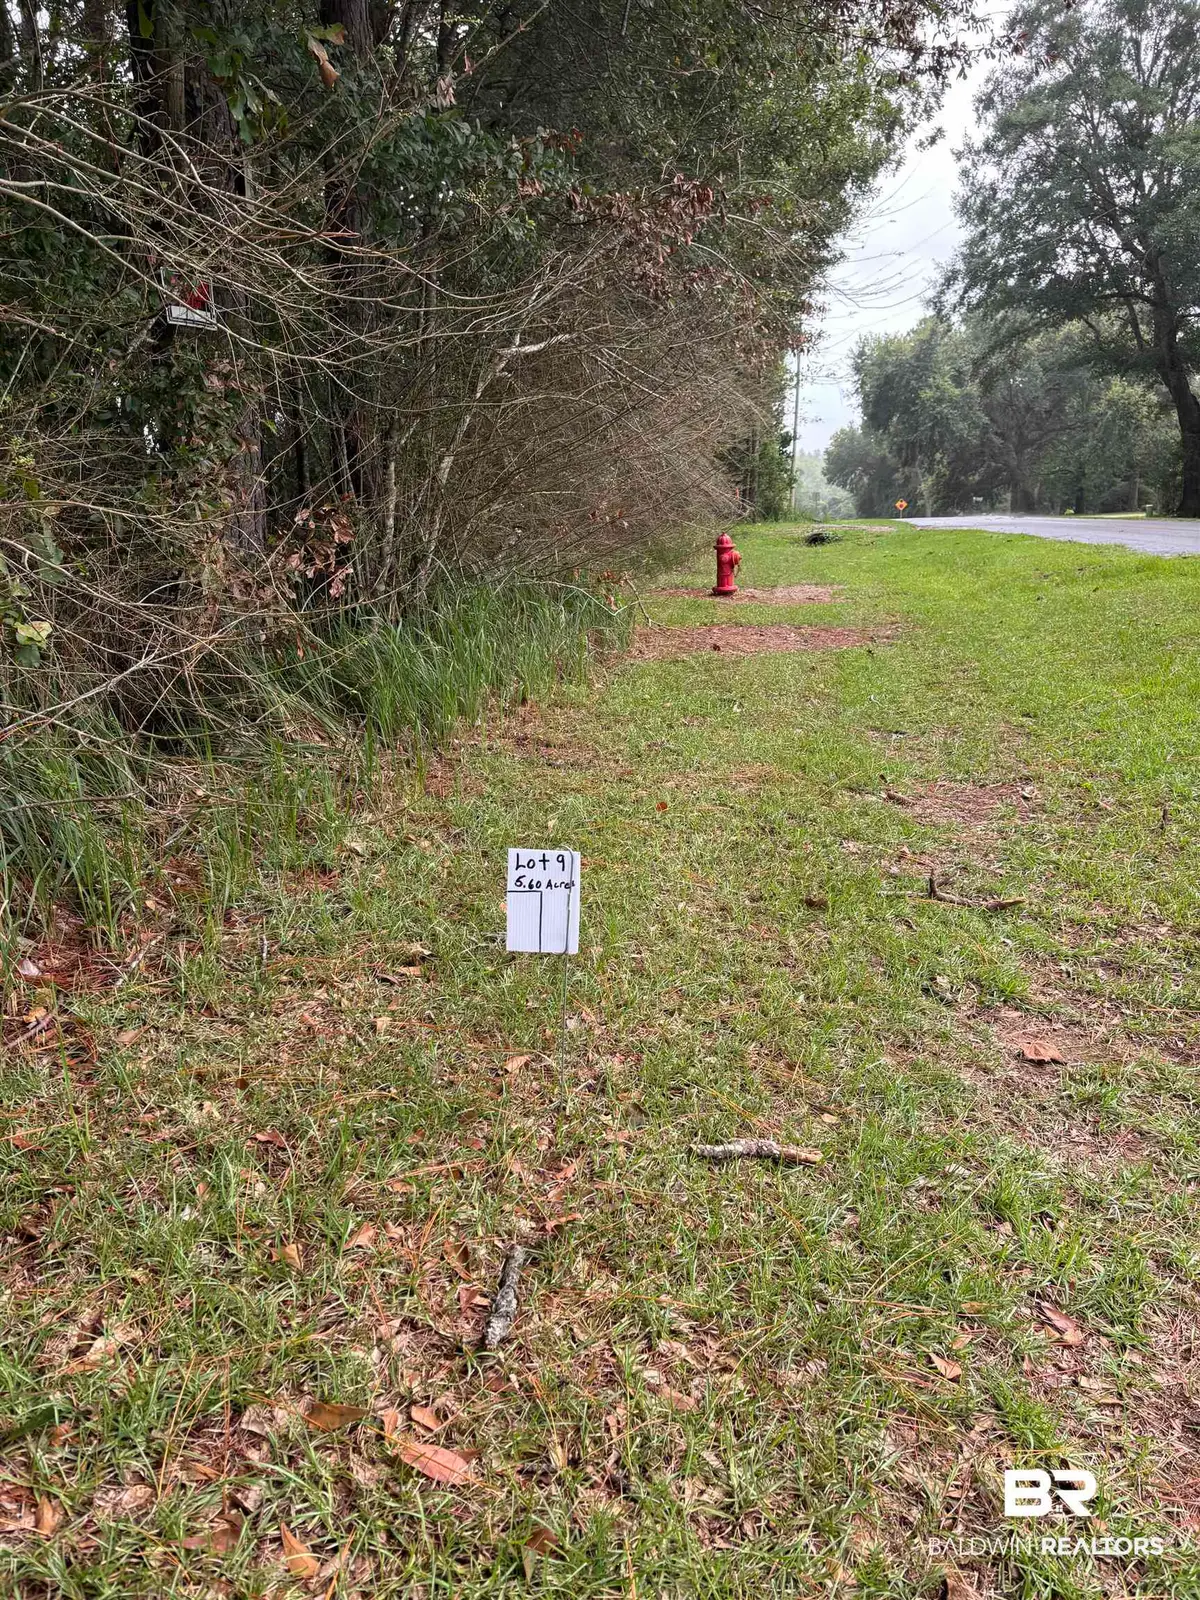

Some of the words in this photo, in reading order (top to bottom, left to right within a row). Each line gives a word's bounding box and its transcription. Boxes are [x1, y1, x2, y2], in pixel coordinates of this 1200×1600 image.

[515, 853, 550, 871] Lot
[556, 854, 566, 872] 9
[514, 875, 542, 890] 5.60
